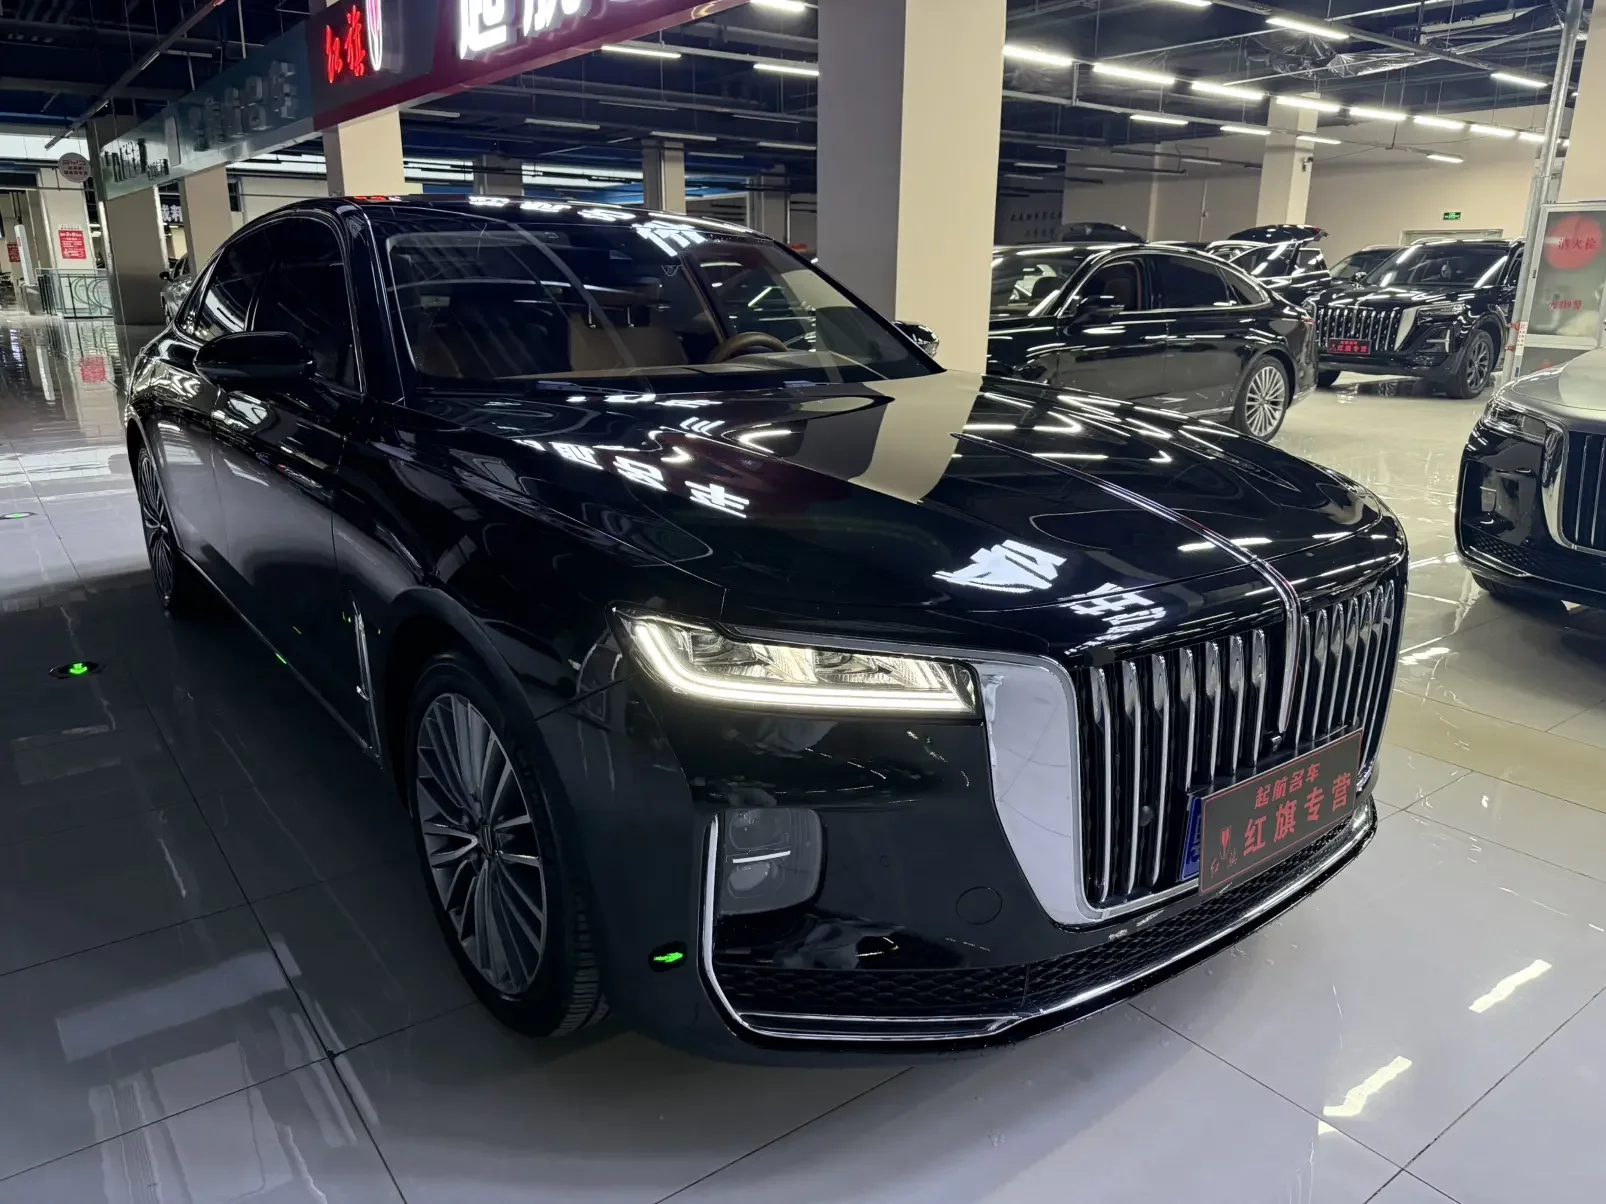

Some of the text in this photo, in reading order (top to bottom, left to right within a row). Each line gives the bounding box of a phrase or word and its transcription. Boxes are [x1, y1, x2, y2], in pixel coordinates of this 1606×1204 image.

[1243, 771, 1352, 857] 红旗专营
[1254, 762, 1321, 809] 起航名车
